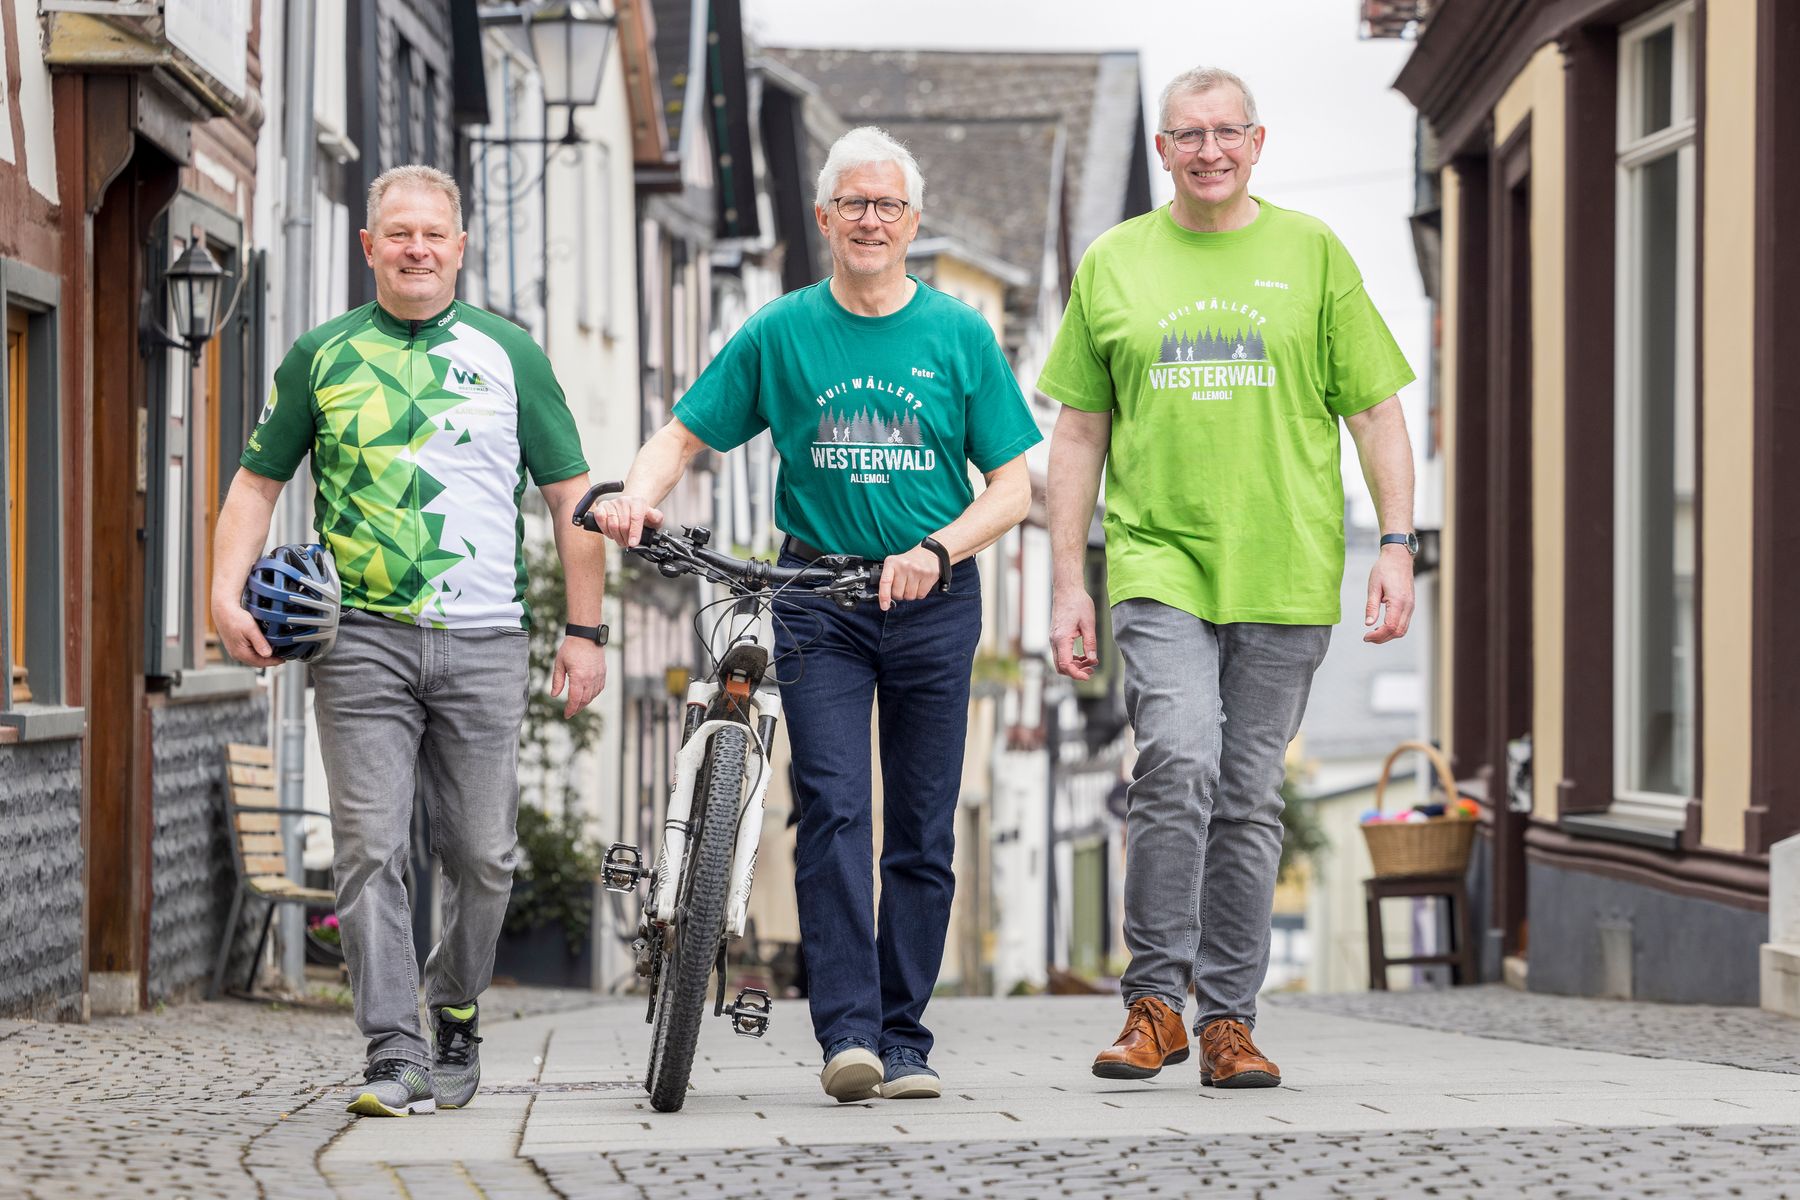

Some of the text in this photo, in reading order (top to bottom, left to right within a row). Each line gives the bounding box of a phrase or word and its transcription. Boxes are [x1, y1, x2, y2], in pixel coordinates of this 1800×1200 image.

[1254, 279, 1288, 289] Andreas
[1158, 296, 1267, 329] HUI! WÄLLER?
[912, 367, 935, 378] Peter
[1149, 365, 1276, 390] WESTERWALD
[816, 376, 922, 410] HUI! WÄLLER?
[1191, 390, 1233, 401] ALLEMOL!
[811, 447, 935, 471] WESTERWALD
[850, 473, 889, 484] ALLEMOL!
